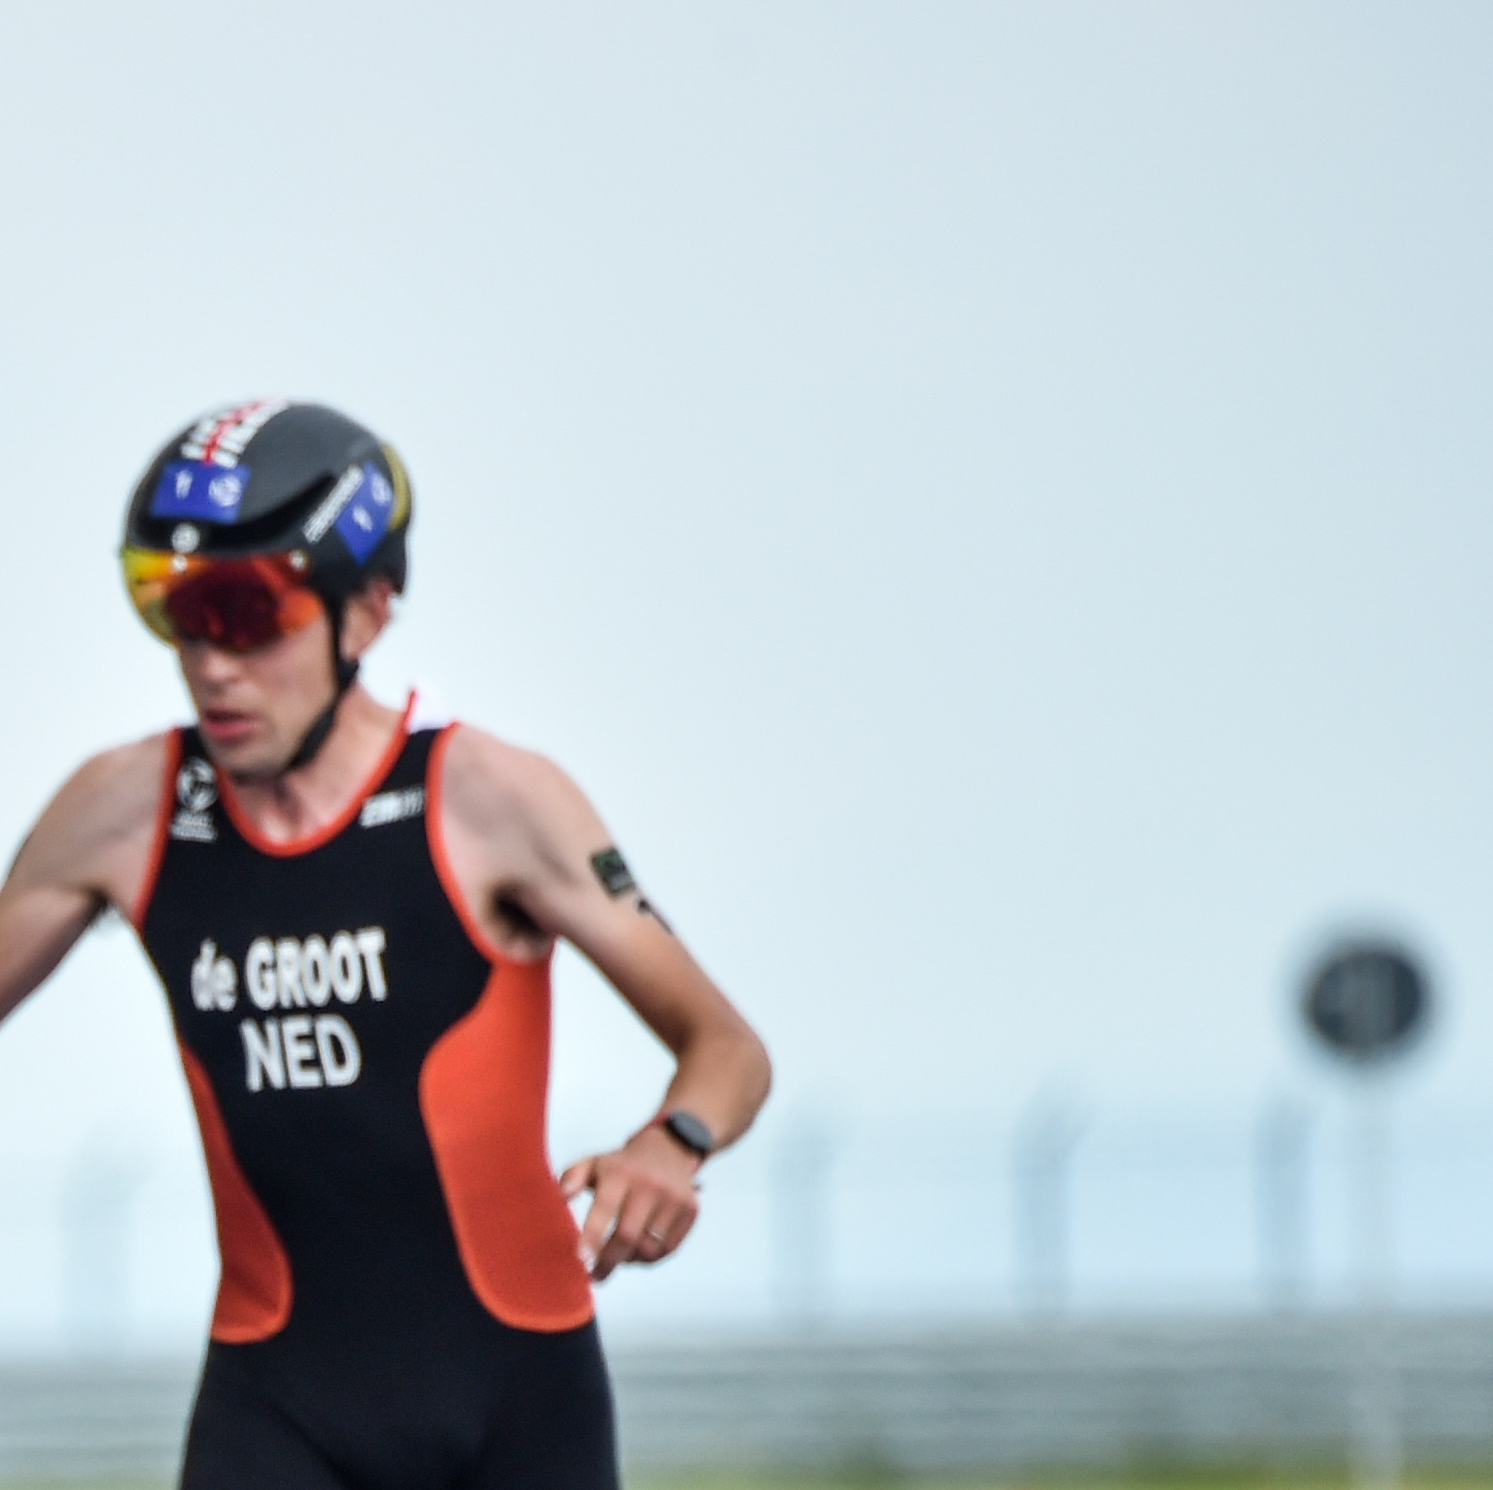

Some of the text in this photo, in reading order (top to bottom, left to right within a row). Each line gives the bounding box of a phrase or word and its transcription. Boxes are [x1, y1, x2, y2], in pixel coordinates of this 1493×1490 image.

[190, 926, 388, 1012] de GROOT
[240, 1013, 361, 1092] NED
